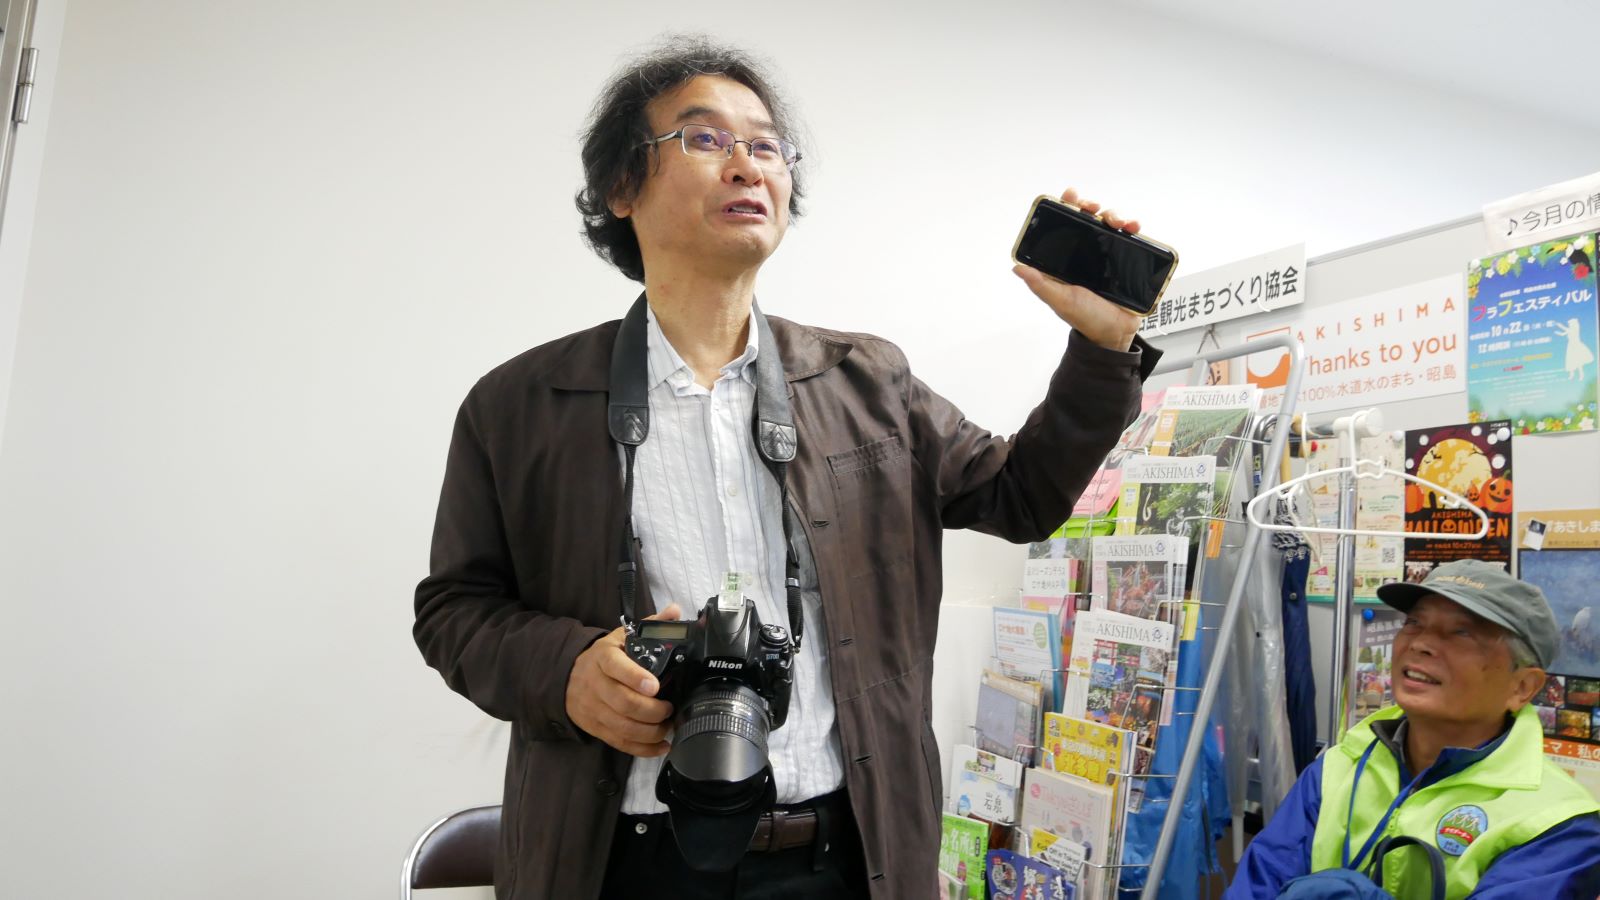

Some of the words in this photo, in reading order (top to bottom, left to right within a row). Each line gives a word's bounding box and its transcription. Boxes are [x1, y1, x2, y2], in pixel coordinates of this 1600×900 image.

[1139, 266, 1298, 332] 島観光まちづくり協会
[1472, 289, 1593, 322] フラフェスティバル
[1305, 347, 1370, 376] hanks
[1380, 344, 1403, 364] to
[1412, 333, 1457, 364] you
[1183, 393, 1236, 406] AKISHIMA
[1143, 466, 1194, 479] AKISHIMA
[1107, 543, 1154, 556] AKISHIMA
[1096, 623, 1151, 641] AKISHIMA
[708, 660, 743, 669] Nikon
